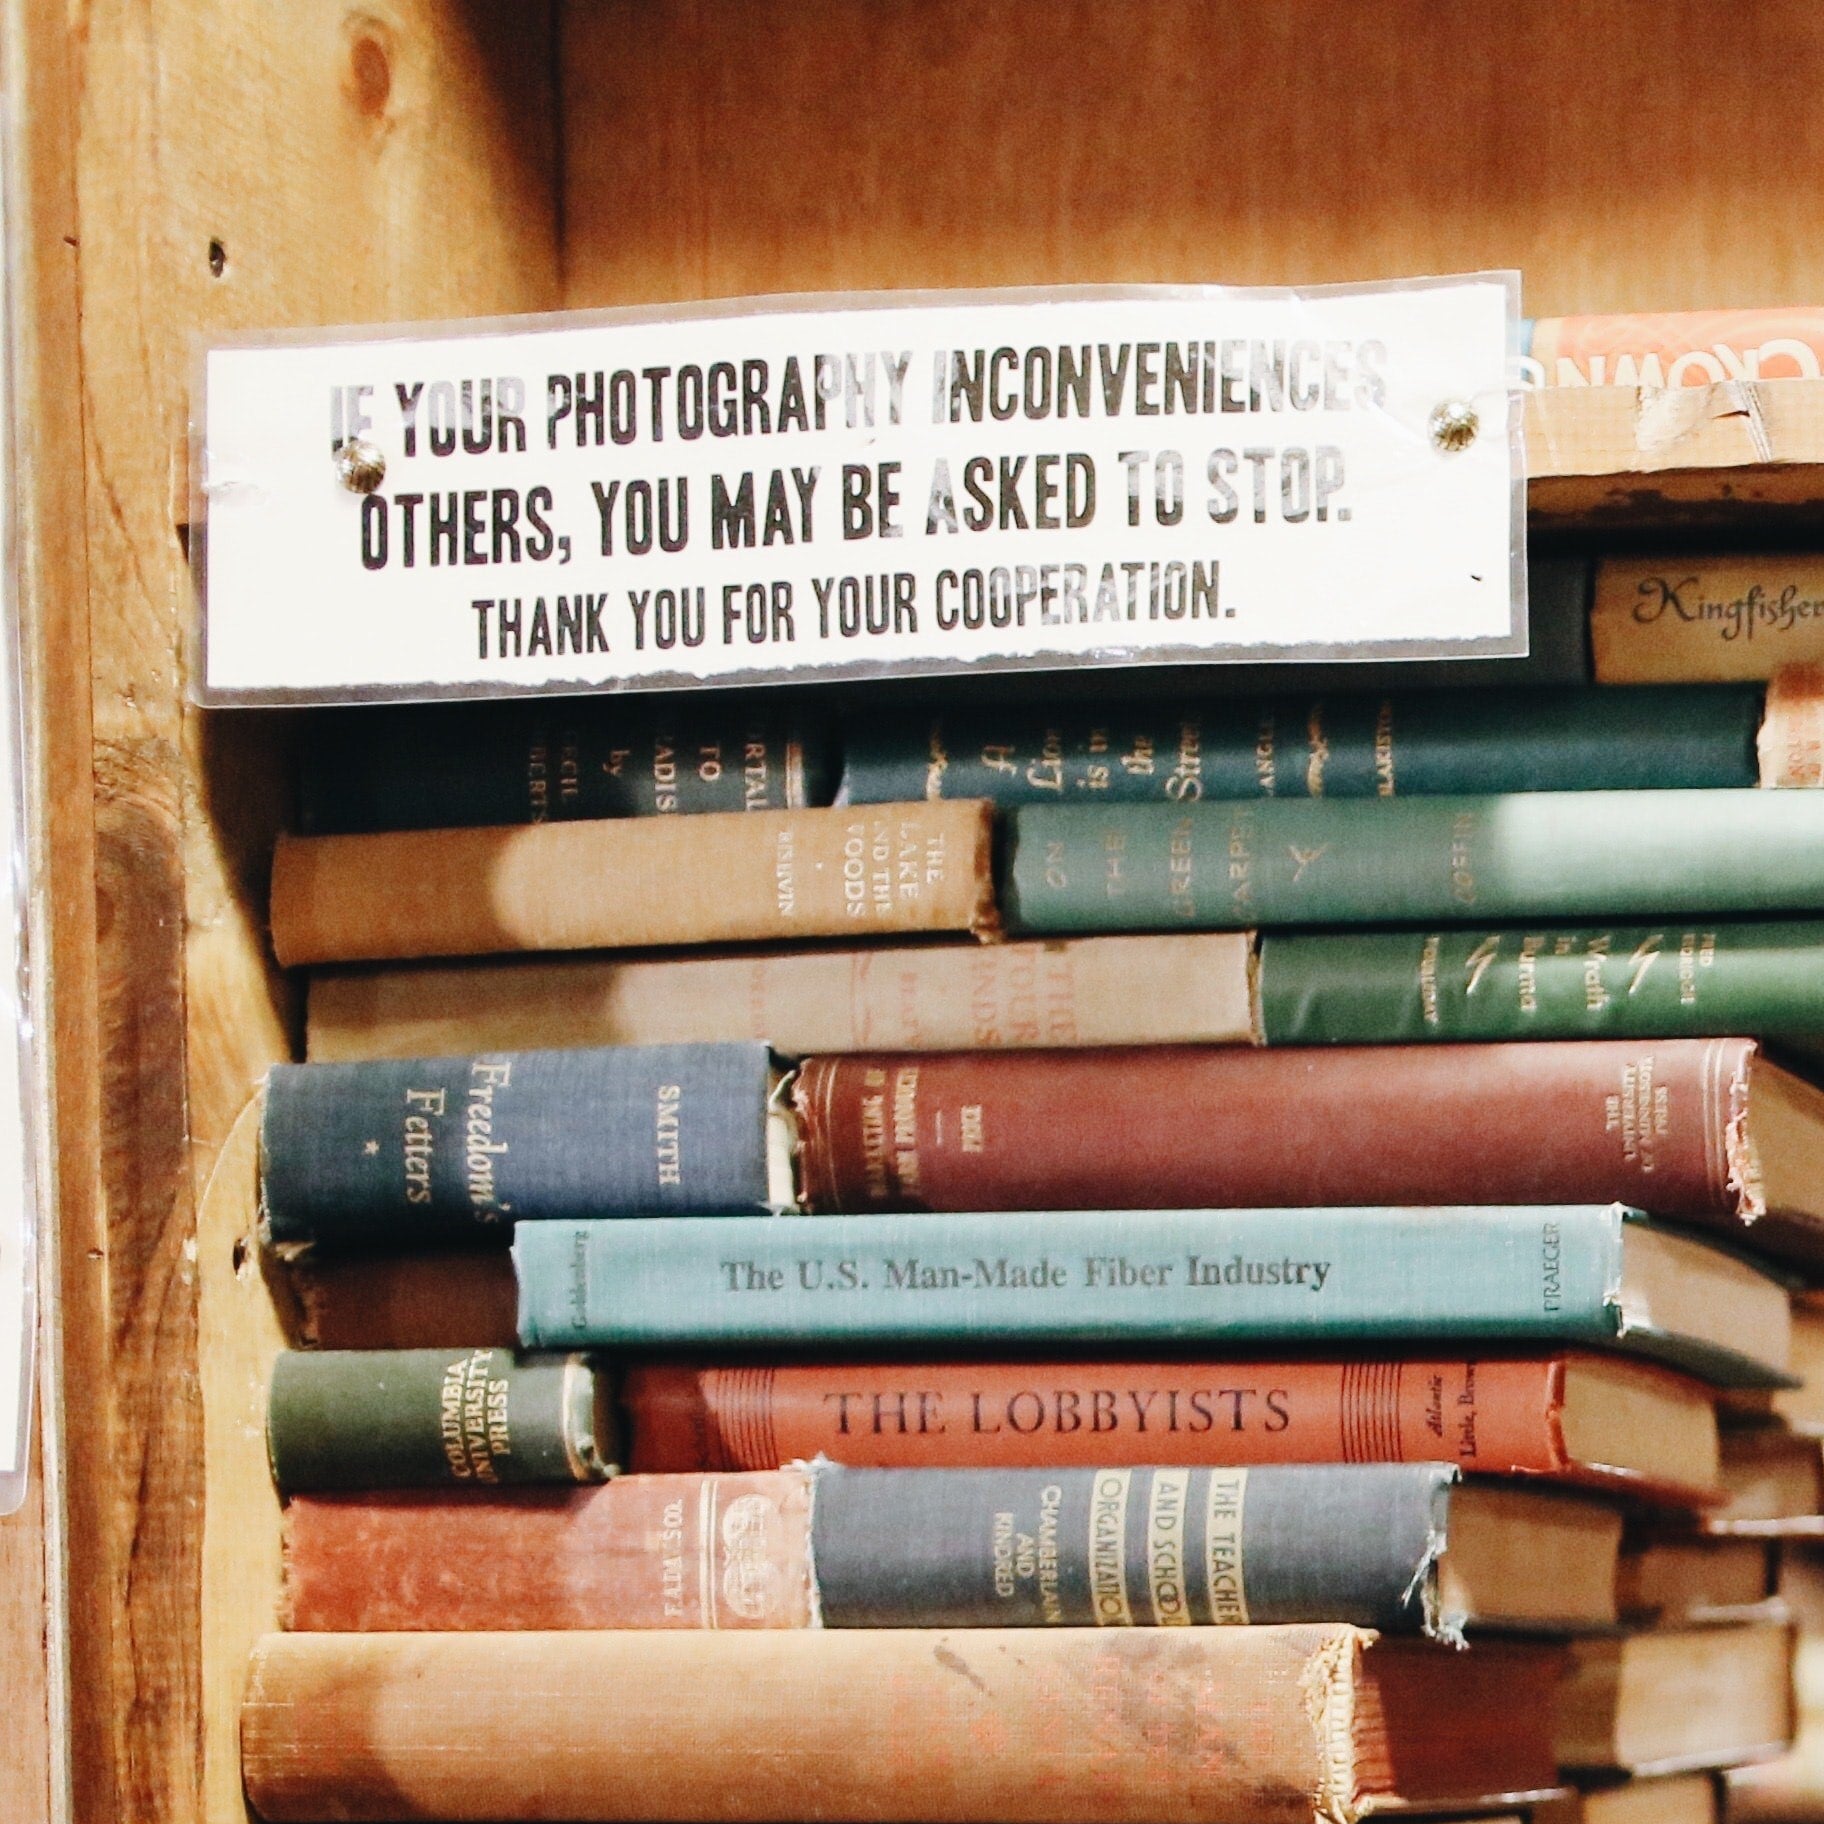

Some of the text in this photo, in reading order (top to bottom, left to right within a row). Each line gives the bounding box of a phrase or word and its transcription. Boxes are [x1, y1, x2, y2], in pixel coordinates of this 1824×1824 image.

[329, 339, 1388, 457] IF YOUR PHOTOGRAPHY INCONVENIENCES
[360, 445, 1352, 568] OTHERS, YOU MAY BE ASKED TO STOP.
[470, 562, 1234, 660] THANK YOU FOR YOUR COOPERATION.
[406, 1086, 447, 1204] Fetters
[463, 1058, 514, 1224] Freedom's
[659, 1085, 679, 1184] SMITH
[721, 1255, 1330, 1293] The U.S. Man-Made Fiber Industry
[1543, 1221, 1561, 1312] PRAEGER
[489, 1377, 510, 1459] PRESS
[824, 1388, 1291, 1434] THE LOBBYISTS
